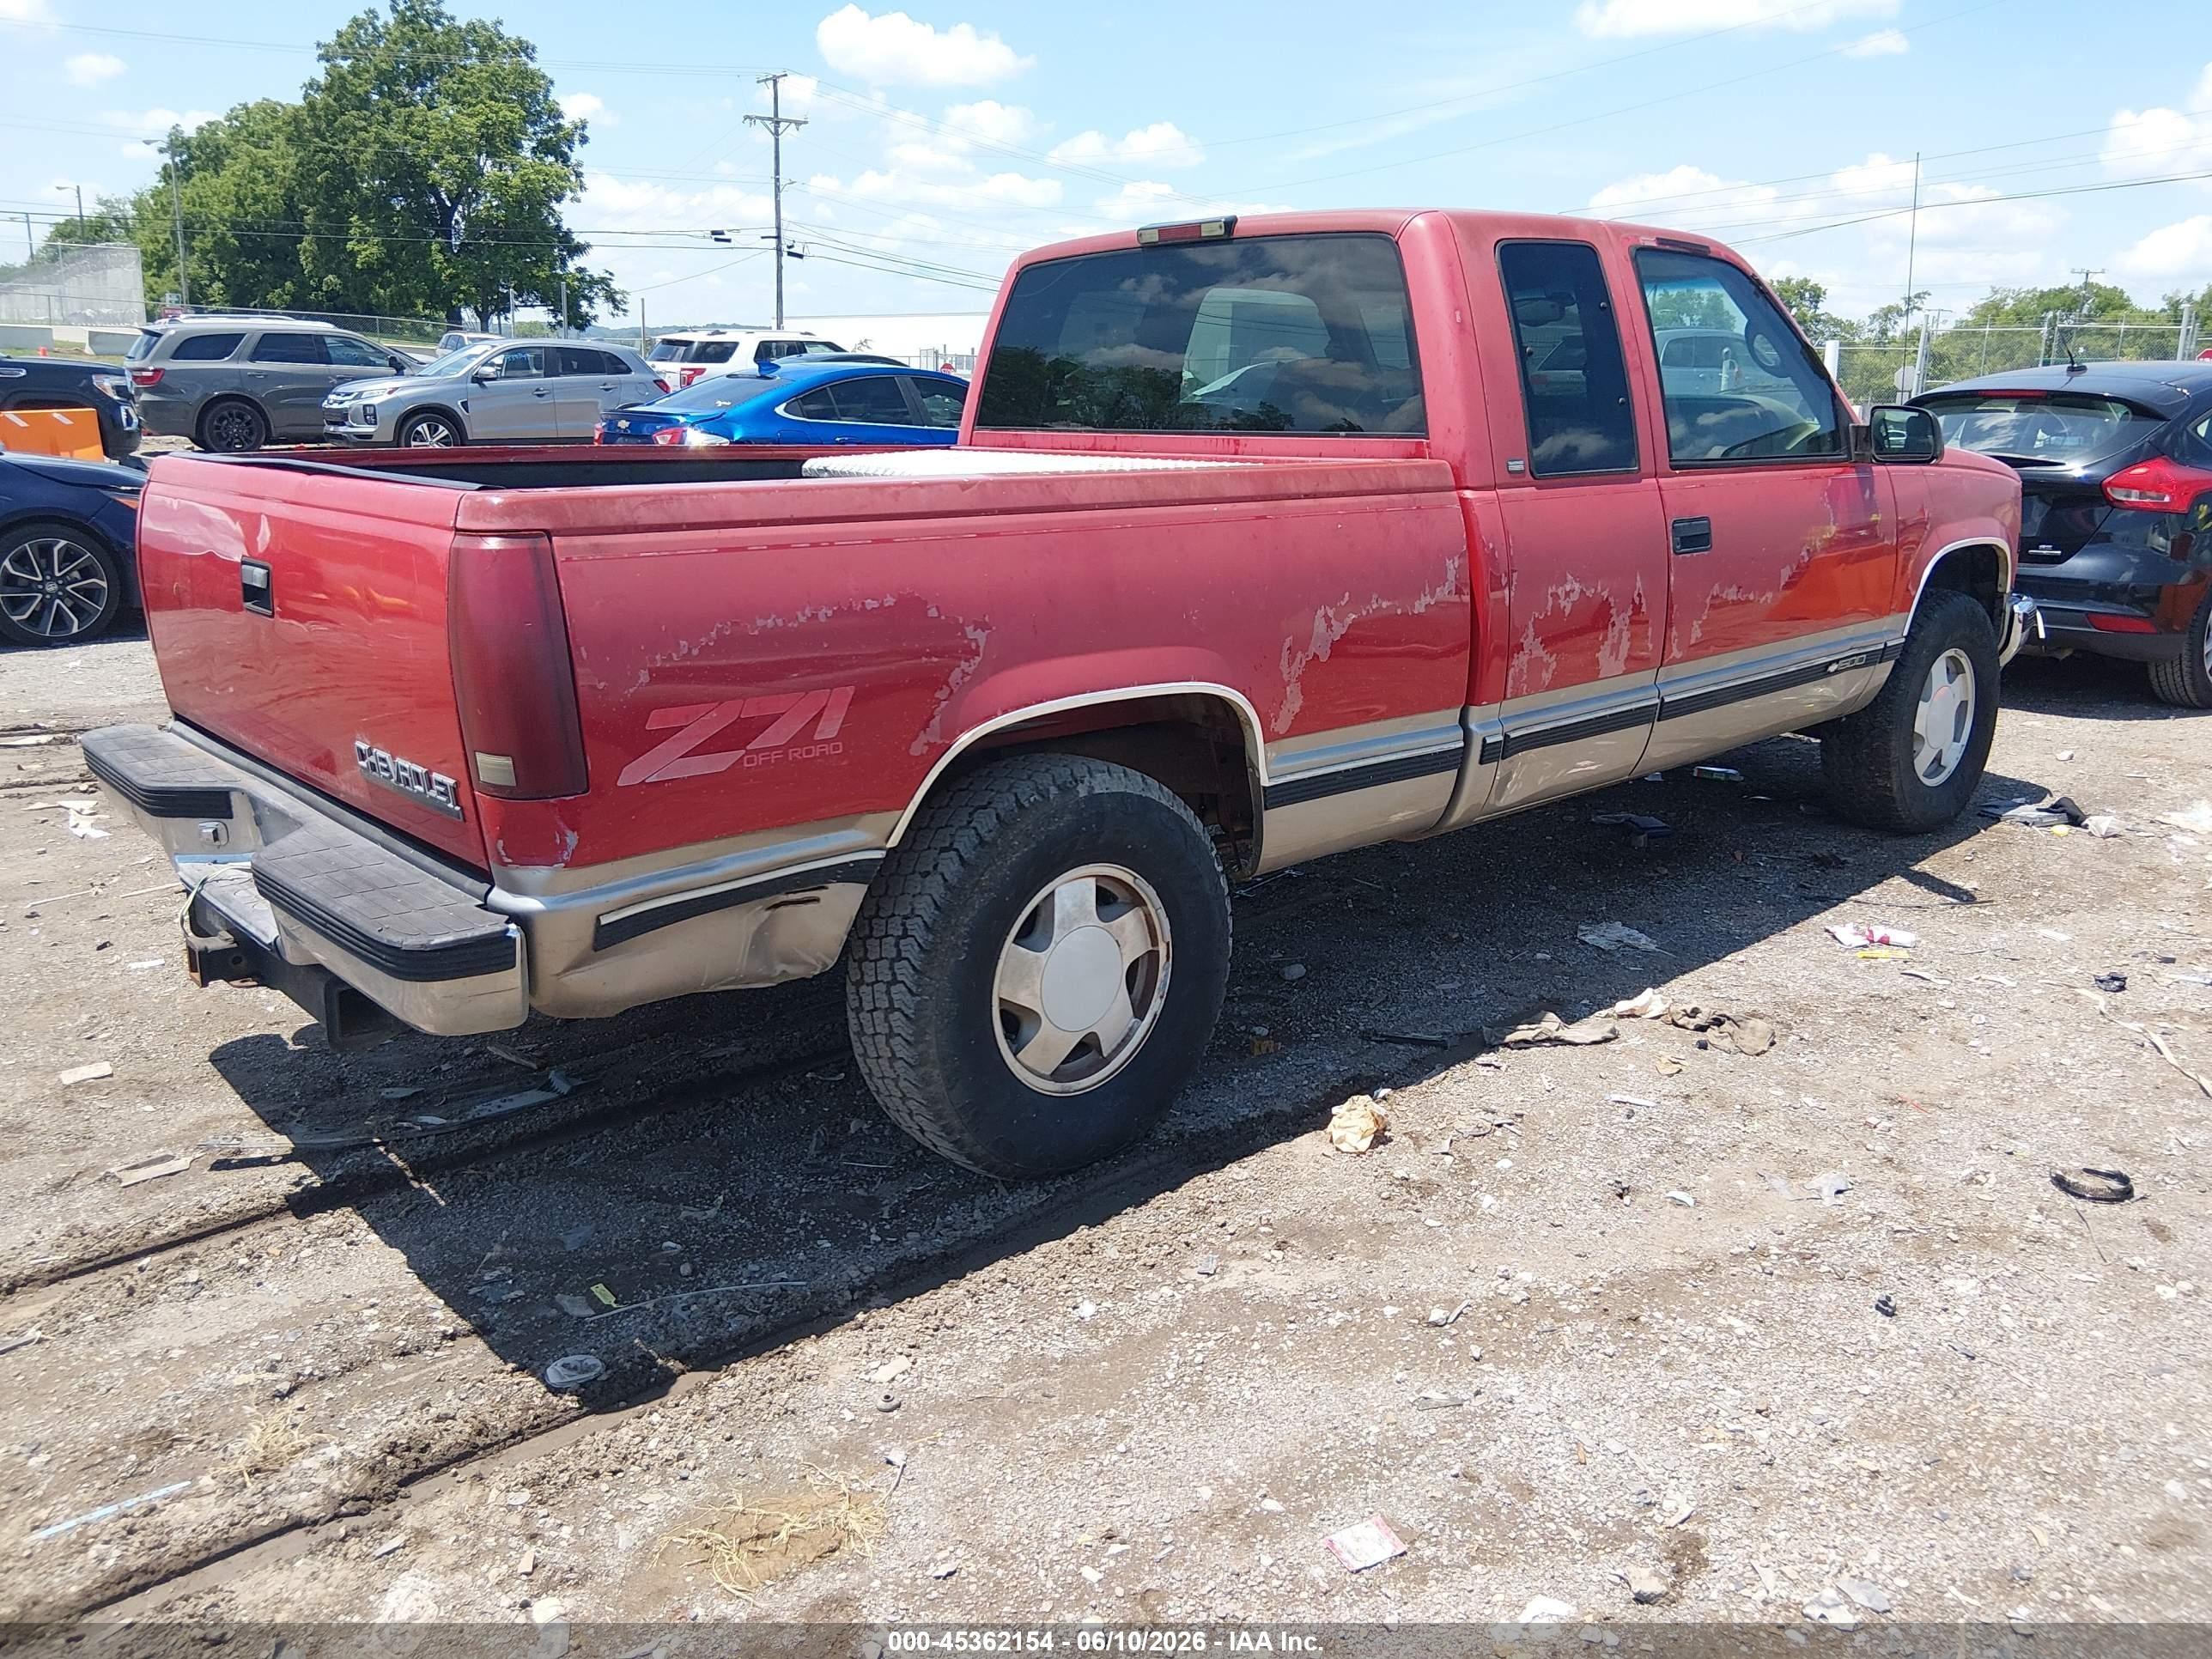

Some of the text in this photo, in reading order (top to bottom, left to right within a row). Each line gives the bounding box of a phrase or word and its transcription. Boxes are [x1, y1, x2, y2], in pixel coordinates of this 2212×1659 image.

[617, 685, 855, 787] Z71
[743, 741, 843, 768] OFF ROAD
[355, 740, 461, 811] CHEVROLET
